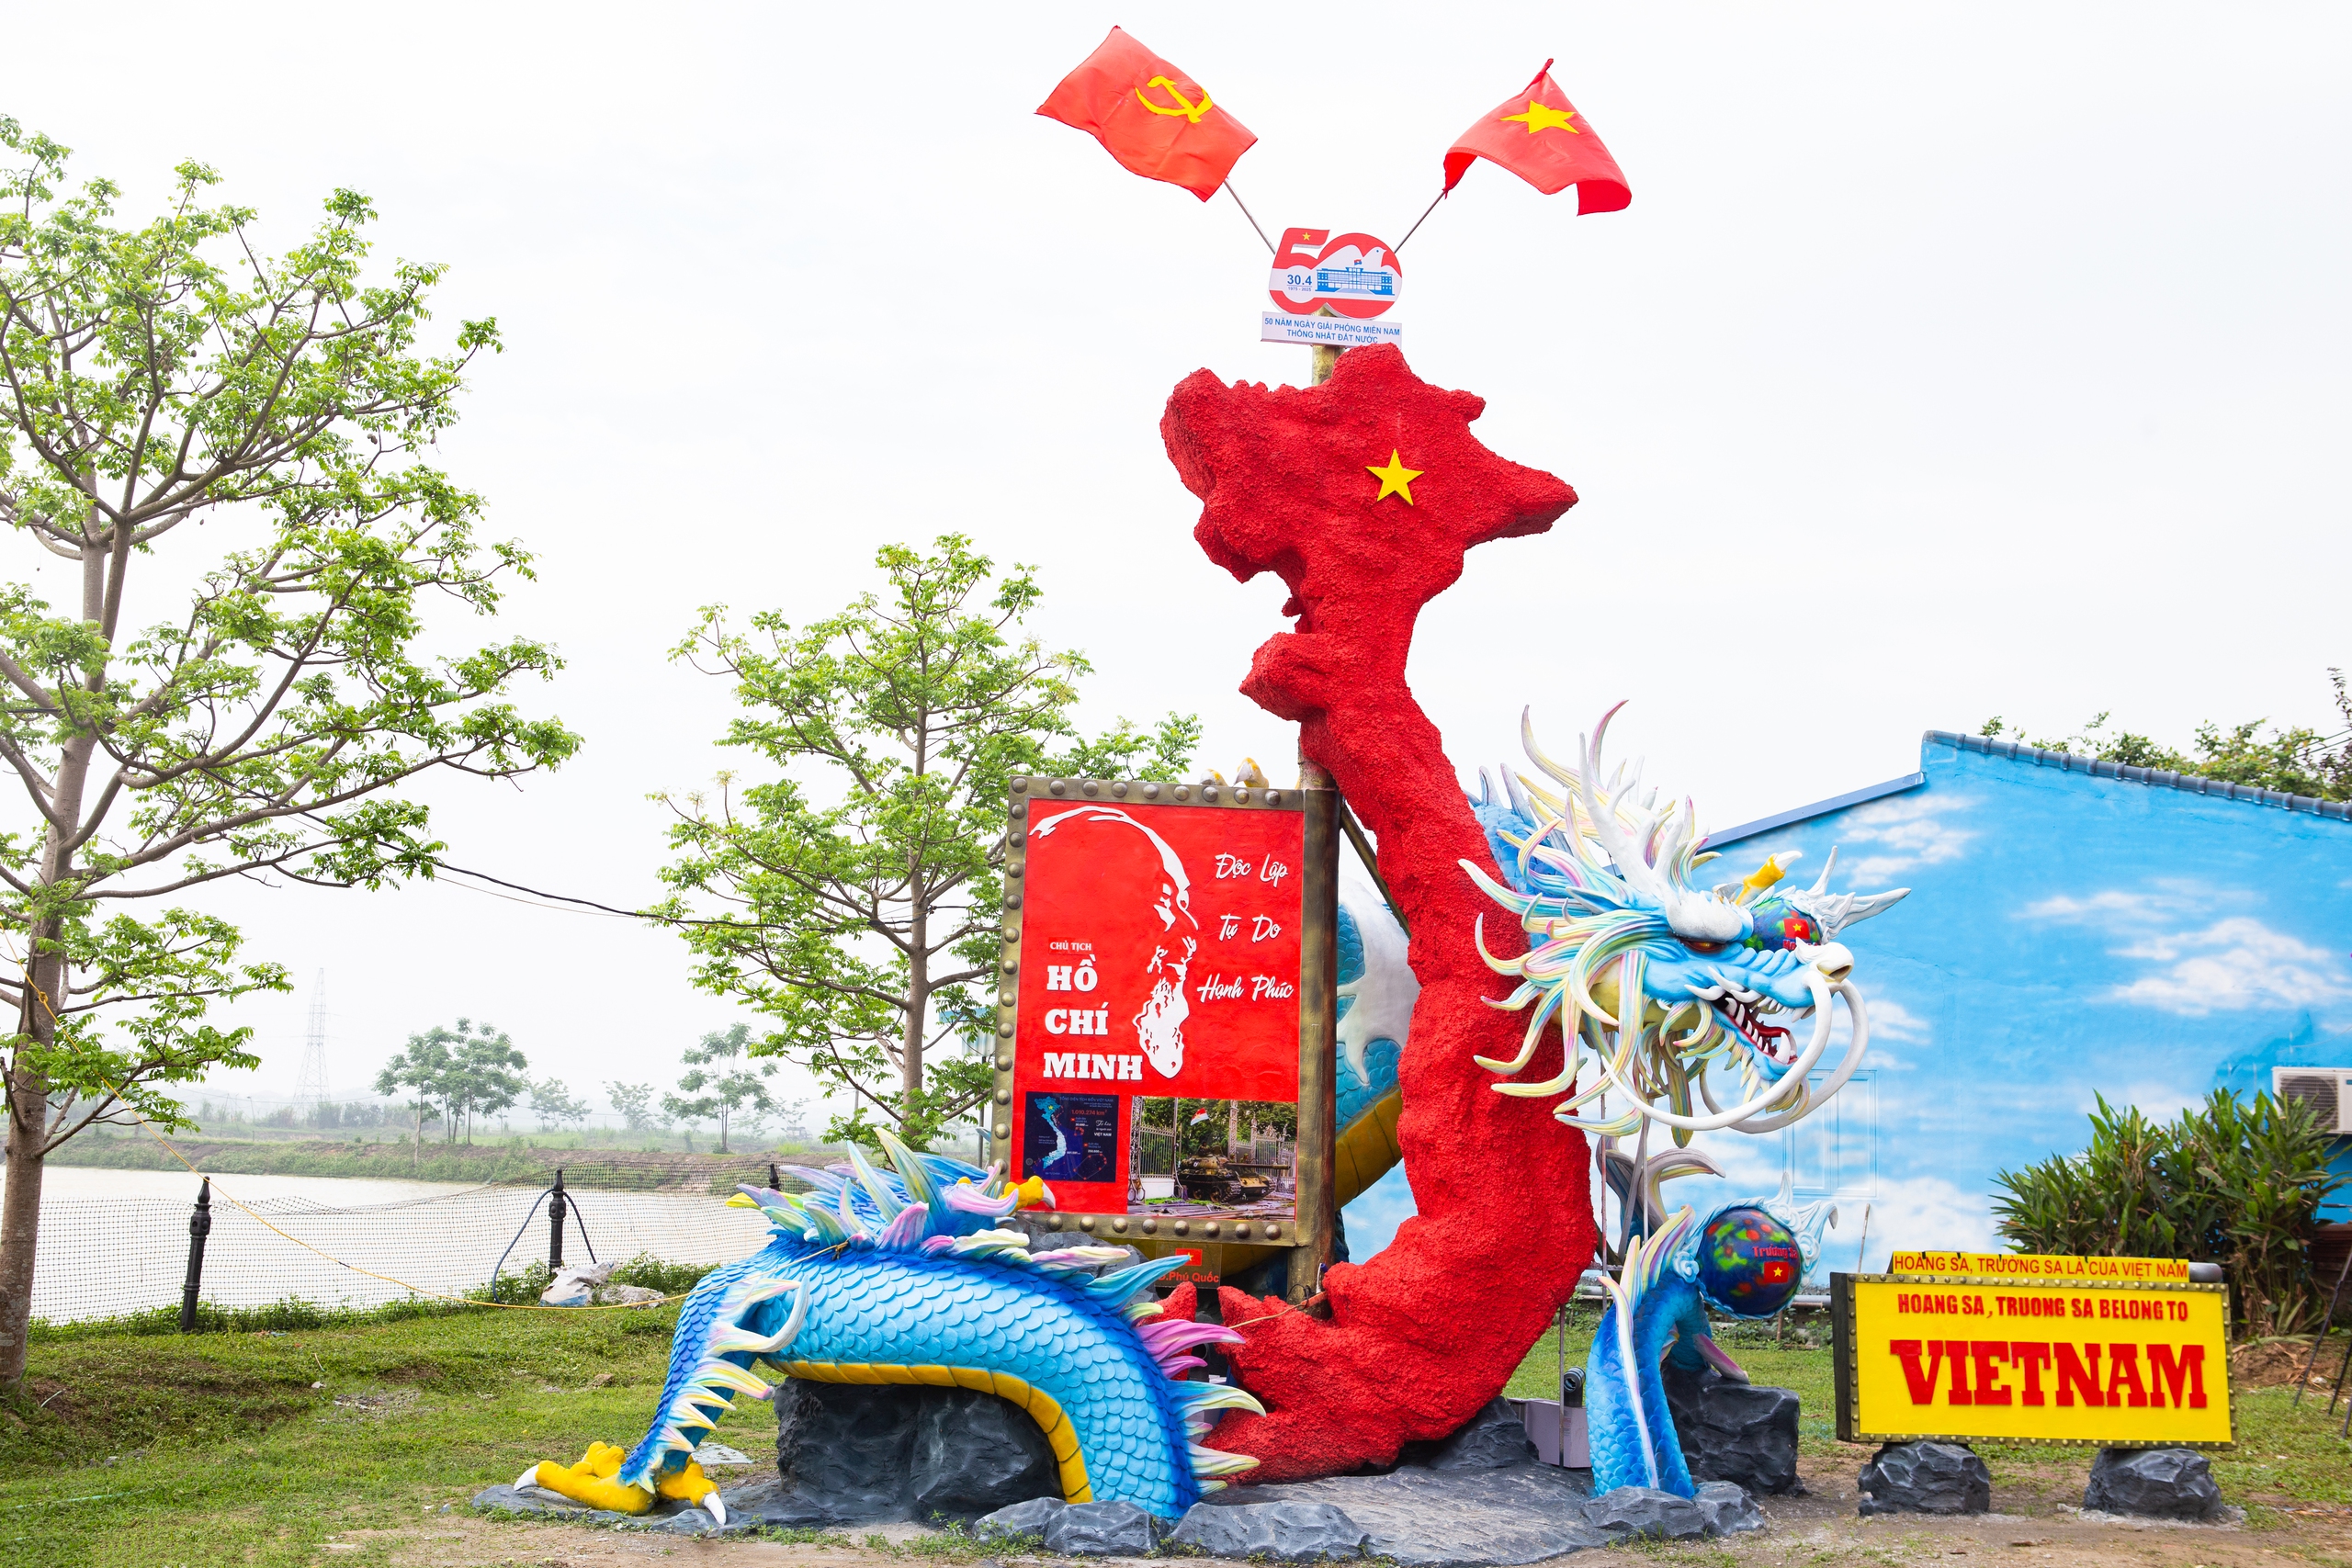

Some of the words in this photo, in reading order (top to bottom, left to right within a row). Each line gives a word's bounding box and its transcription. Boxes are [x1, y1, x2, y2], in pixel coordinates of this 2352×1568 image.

[1287, 274, 1312, 285] 30.4
[1275, 318, 1292, 326] NĂM
[1295, 320, 1316, 328] NGÀY
[1317, 321, 1332, 330] GIẢI
[1334, 323, 1362, 333] PHÓNG
[1215, 852, 1251, 879] Độc
[1260, 853, 1288, 887] Lập
[1219, 913, 1242, 942] Tự
[1251, 914, 1282, 942] Do
[1050, 941, 1069, 950] CHỦ
[1071, 942, 1092, 952] TỊCH
[1046, 954, 1098, 992] HỒ
[1197, 973, 1244, 1003] Hạnh
[1251, 975, 1294, 1001] Phúc
[1045, 1002, 1109, 1035] CHÍ
[1044, 1053, 1143, 1080] MINH
[1193, 1271, 1219, 1282] Quốc
[1894, 1253, 1946, 1270] HOÀNG
[1950, 1257, 1973, 1274] SA,
[1977, 1255, 2040, 1273] TRƯỜNG
[2044, 1260, 2063, 1274] SA
[2067, 1257, 2085, 1275] LÀ
[2088, 1258, 2119, 1276] CỦA
[2122, 1260, 2152, 1280] VIỆT
[2157, 1264, 2188, 1278] NAM
[1897, 1293, 1958, 1314] HOANG
[1996, 1296, 2065, 1317] TRUONG
[2071, 1298, 2094, 1318] SA
[2099, 1299, 2164, 1320] BELONG
[2167, 1301, 2188, 1321] TO
[1890, 1338, 2208, 1409] VIETNAM
